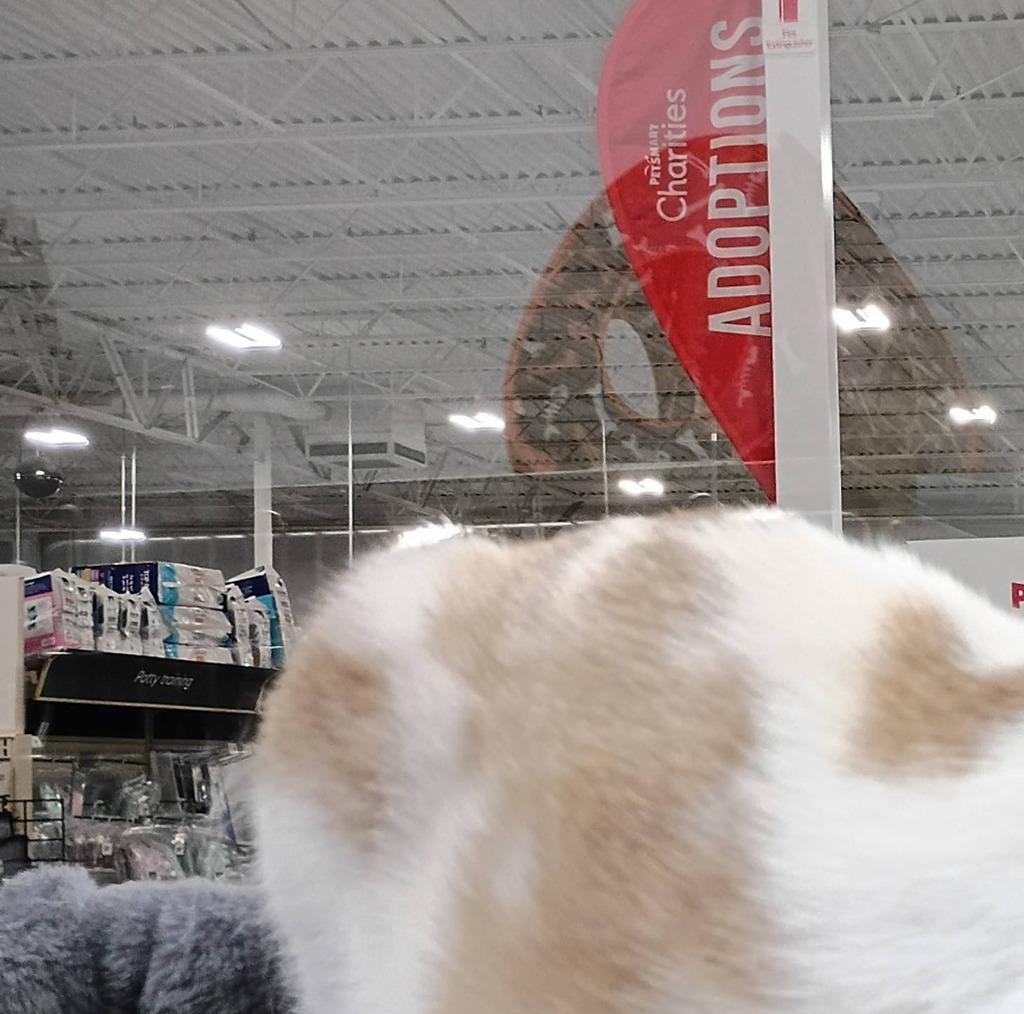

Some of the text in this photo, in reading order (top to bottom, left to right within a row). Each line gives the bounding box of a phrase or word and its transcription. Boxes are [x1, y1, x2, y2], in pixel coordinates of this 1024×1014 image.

[648, 123, 662, 186] PETSMART
[656, 88, 688, 222] Charities
[706, 15, 773, 337] ADOPTIONS
[133, 670, 159, 688] Potty
